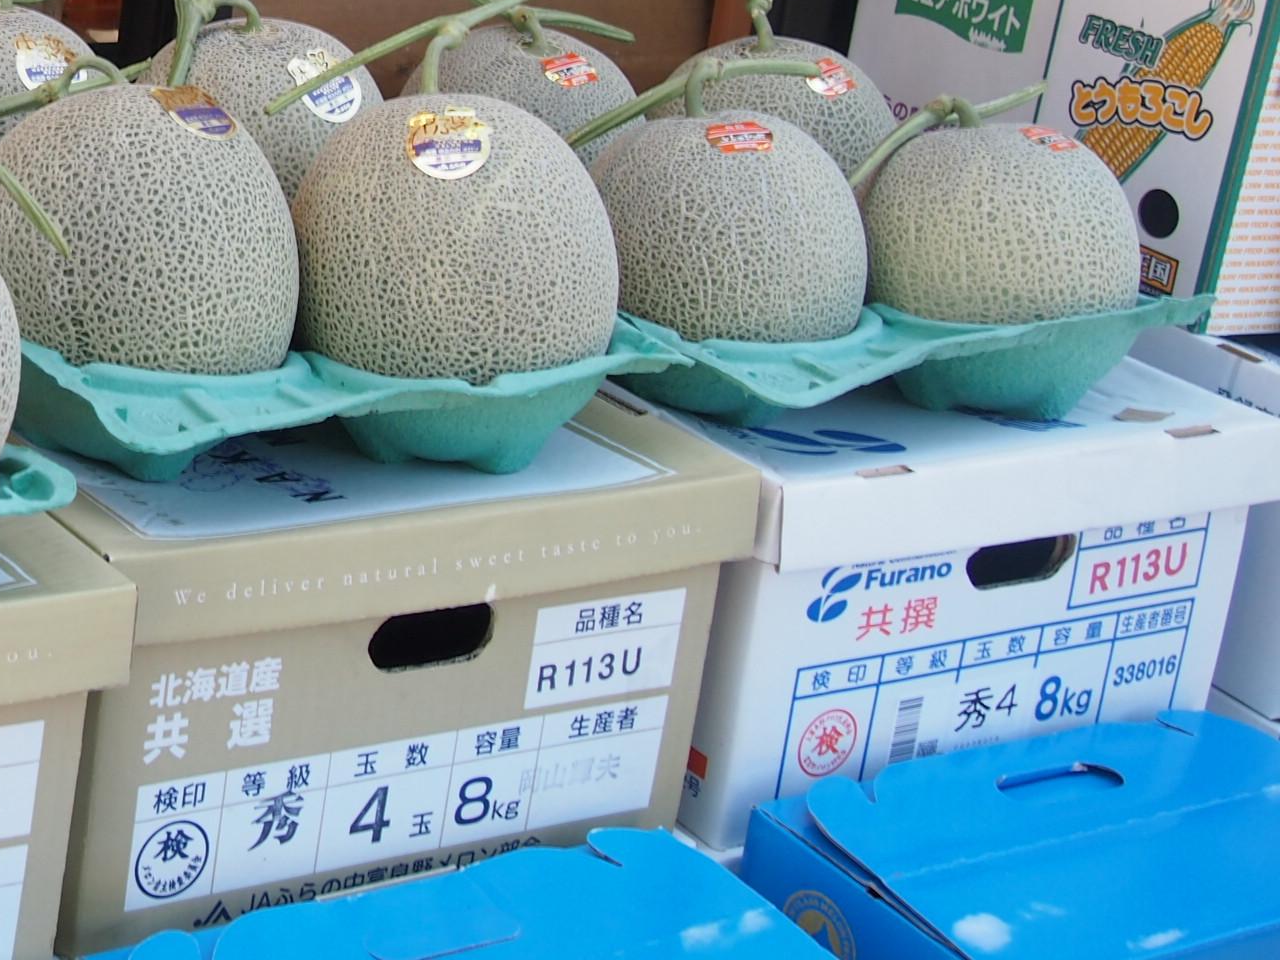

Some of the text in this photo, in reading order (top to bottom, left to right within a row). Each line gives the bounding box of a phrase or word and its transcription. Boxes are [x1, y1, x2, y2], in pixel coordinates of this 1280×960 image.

[1080, 15, 1163, 69] FRESH
[1070, 77, 1213, 140] とうもろこし
[174, 587, 207, 606] We
[225, 575, 323, 601] deliver
[343, 557, 438, 586] natural
[455, 547, 525, 571] sweet
[540, 537, 602, 559] taste
[615, 530, 637, 546] to
[865, 562, 952, 590] Furano
[1089, 542, 1188, 594] R113U
[575, 600, 644, 634] 品種名
[149, 657, 283, 710] 北海道産
[536, 647, 642, 694] R113U
[1113, 654, 1177, 686] 338016
[1035, 676, 1092, 721] 8kg
[153, 706, 639, 815] 検印 等級 玉数 容量 生産者
[154, 829, 193, 862] 検
[248, 791, 304, 852] 秀
